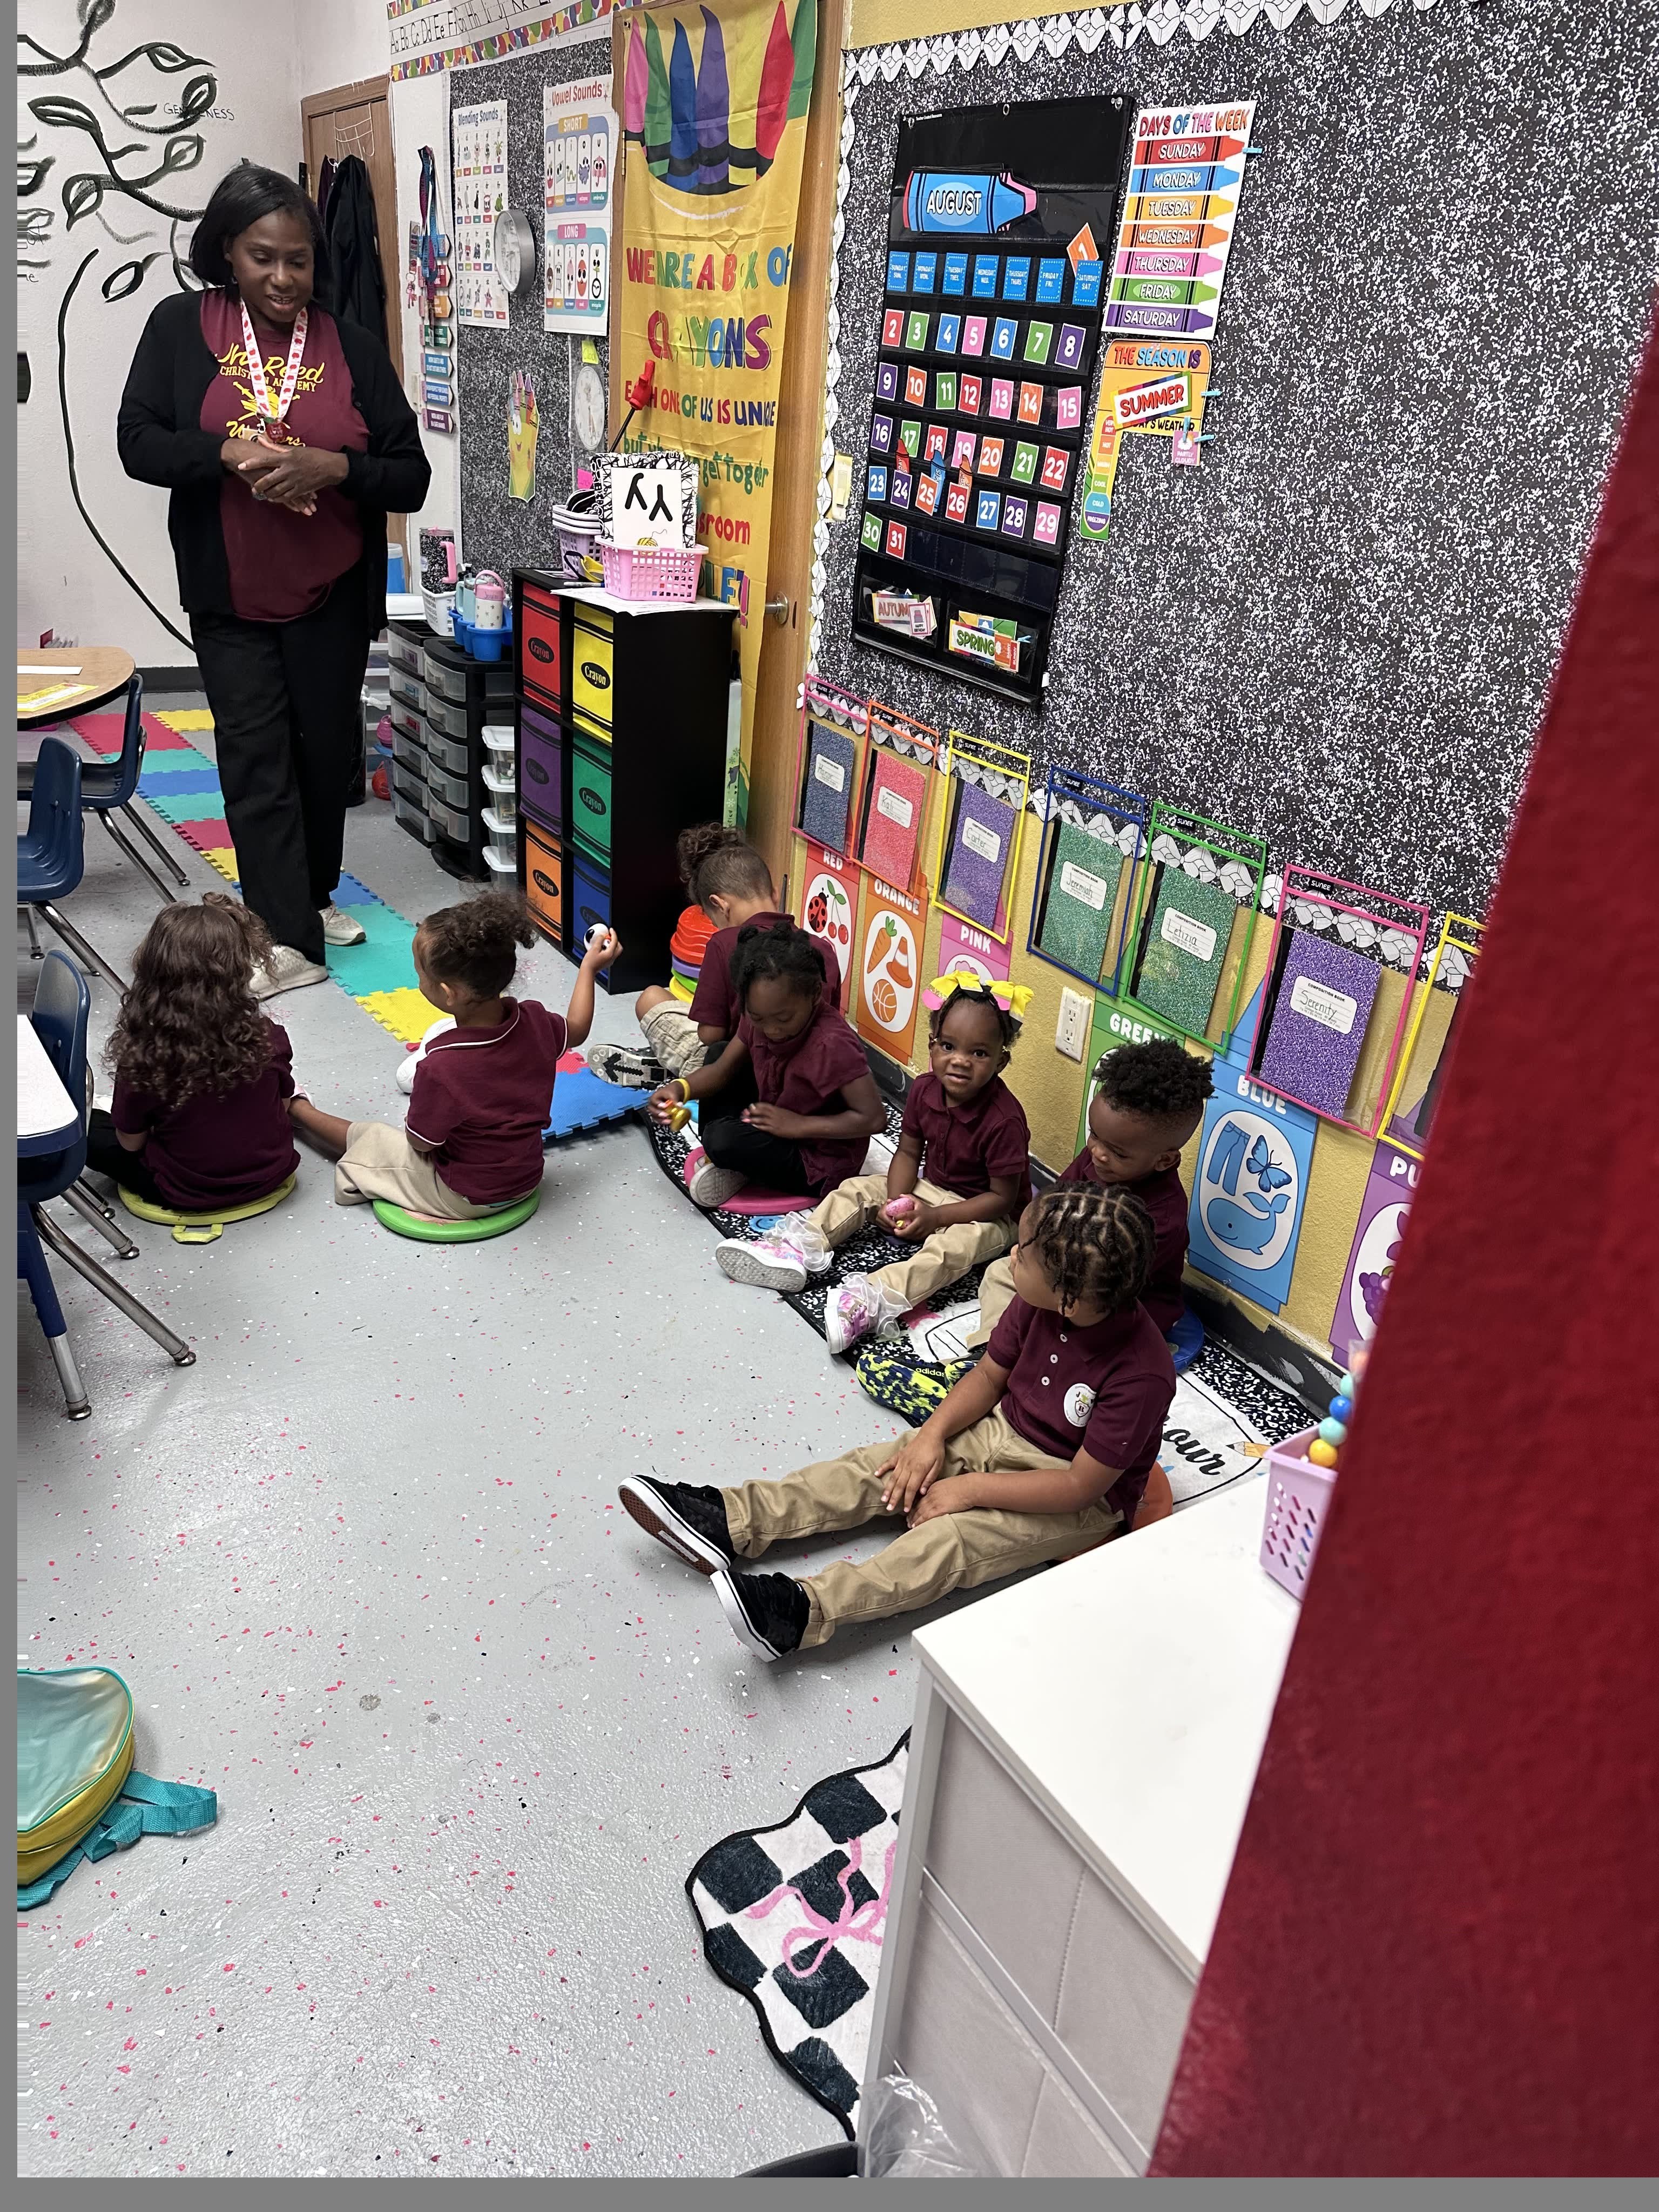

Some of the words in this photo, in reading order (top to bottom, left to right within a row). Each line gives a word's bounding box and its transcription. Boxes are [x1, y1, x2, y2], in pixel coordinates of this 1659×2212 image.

[552, 86, 571, 106] Vowel
[573, 80, 603, 102] Sounds
[480, 107, 498, 121] Sounds
[563, 116, 583, 132] SHORT
[1139, 115, 1172, 137] DAYS
[1173, 114, 1190, 135] OF
[1191, 112, 1215, 133] THE
[1215, 109, 1250, 131] WEEK
[1159, 143, 1205, 160] SUNDAY
[1152, 172, 1201, 188] MONDAY
[926, 190, 982, 216] AUGUST
[1149, 200, 1197, 216] TUESDAY
[564, 225, 578, 238] LONG
[1138, 229, 1197, 244] WEDNESDAY
[626, 247, 656, 285] WE
[696, 254, 715, 291] A
[722, 251, 759, 292] BOX
[1135, 257, 1190, 272] THURSDAY
[1139, 284, 1177, 299] FRIDAY
[1124, 310, 1181, 327] SATURDAY
[889, 319, 897, 339] 2
[912, 321, 921, 341] 3
[943, 325, 952, 343] 4
[969, 326, 978, 346] 5
[999, 328, 1009, 349] 6
[1033, 332, 1044, 353] 7
[1064, 335, 1076, 358] 8
[1115, 346, 1135, 366] THE
[1136, 347, 1187, 367] SEASON
[1188, 349, 1202, 368] IS
[883, 372, 892, 390] 9
[909, 376, 923, 397] 10
[941, 381, 952, 401] 11
[964, 384, 977, 406] 12
[995, 389, 1008, 410] 13
[1023, 393, 1037, 415] 14
[1061, 397, 1077, 419] 15
[1120, 383, 1185, 417] SUMMER
[682, 394, 698, 419] OF
[700, 397, 713, 423] US
[717, 399, 731, 424] IS
[875, 423, 888, 443] 16
[904, 430, 917, 448] 17
[930, 435, 943, 453] 18
[957, 441, 972, 459] 19
[982, 447, 1001, 467] 20
[1019, 454, 1033, 474] 21
[1044, 458, 1064, 481] 22
[870, 474, 884, 492] 23
[894, 479, 908, 500] 24
[919, 484, 934, 505] 25
[949, 492, 965, 513] 26
[981, 500, 997, 521] 27
[1007, 505, 1024, 528] 28
[1037, 511, 1057, 534] 29
[1092, 500, 1104, 508] COLD
[864, 524, 879, 542] 30
[889, 530, 902, 549] 31
[878, 602, 908, 617] AUTUM
[530, 640, 550, 660] Crayon
[957, 629, 995, 657] SPRING
[584, 665, 606, 686] Crayon
[582, 790, 602, 812] Crayon
[823, 849, 843, 871] RED
[535, 872, 554, 894] Crayon
[1310, 880, 1331, 892] SUNEE
[874, 878, 920, 916] ORANGE
[960, 925, 992, 955] PINK
[1307, 983, 1334, 997] COMPOSITION
[1300, 990, 1337, 1021] Serenity
[1237, 1075, 1287, 1115] BLUE
[1163, 1415, 1225, 1475] our
